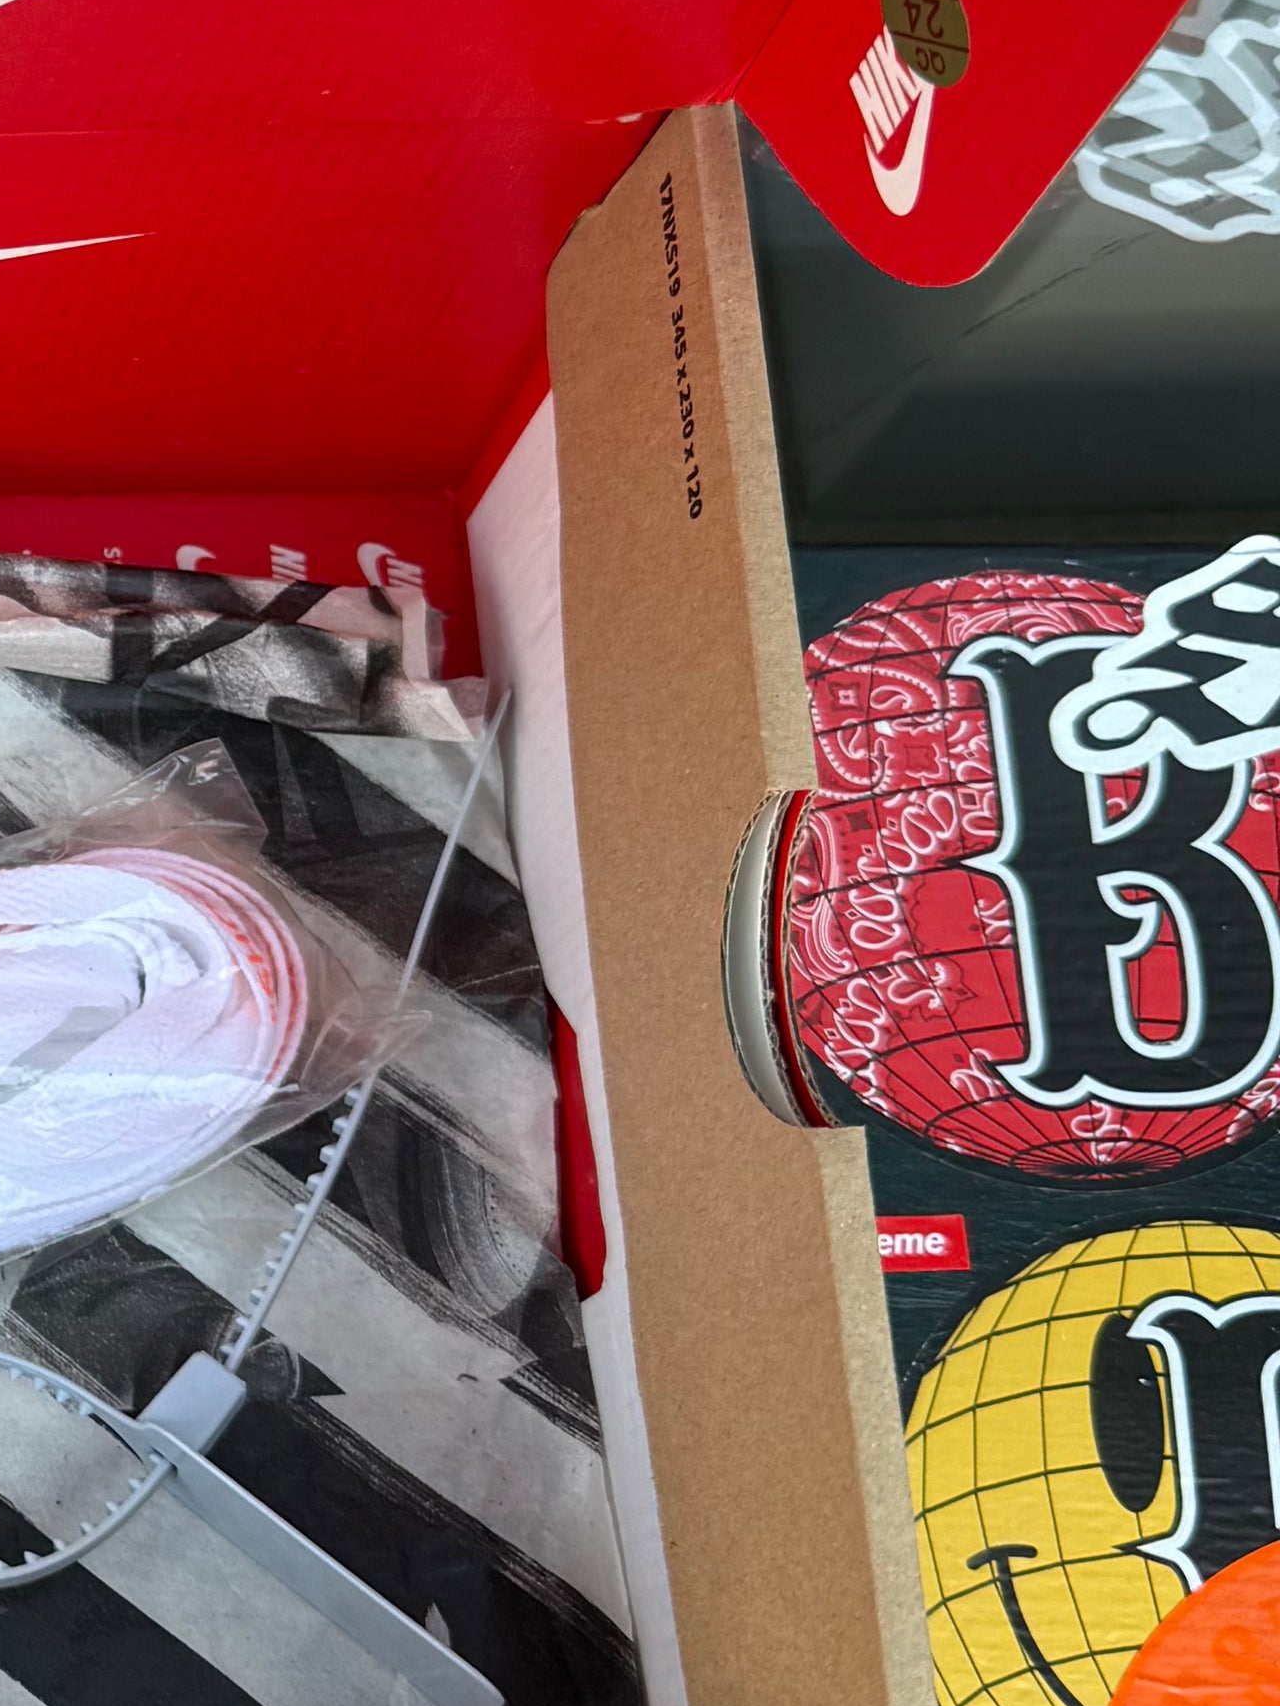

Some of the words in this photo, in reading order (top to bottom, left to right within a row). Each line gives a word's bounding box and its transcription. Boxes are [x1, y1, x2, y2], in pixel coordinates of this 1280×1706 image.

[849, 24, 922, 154] NIK
[916, 47, 946, 75] QC
[678, 386, 694, 440] 230
[686, 465, 702, 519] 120
